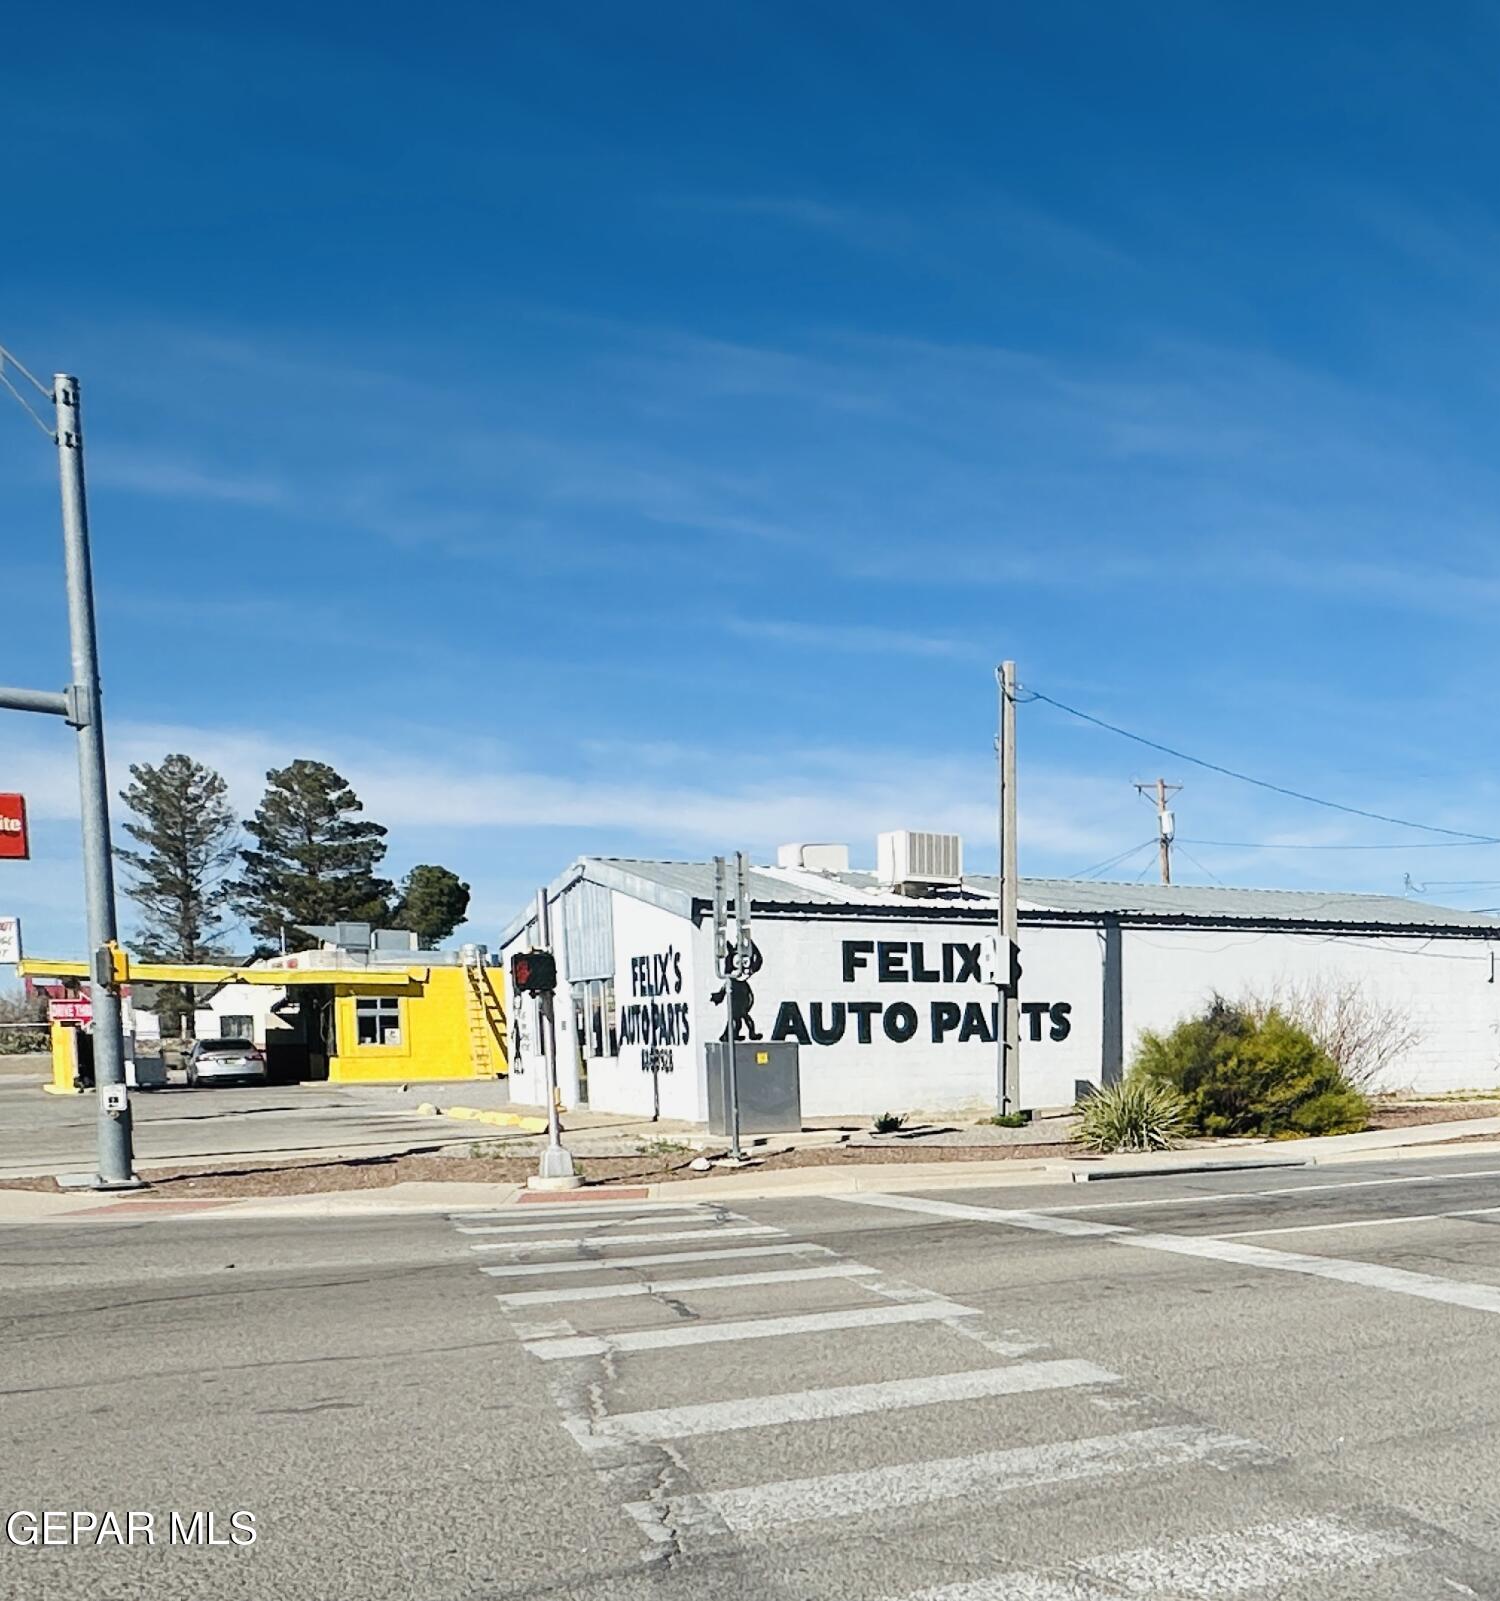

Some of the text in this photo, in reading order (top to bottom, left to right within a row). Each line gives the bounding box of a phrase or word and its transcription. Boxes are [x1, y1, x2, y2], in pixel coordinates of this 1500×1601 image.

[631, 944, 682, 997] FELIX'S
[842, 940, 1022, 983] FELIX
[620, 1002, 690, 1046] AUTO PARTS
[771, 1001, 919, 1046] AUTO
